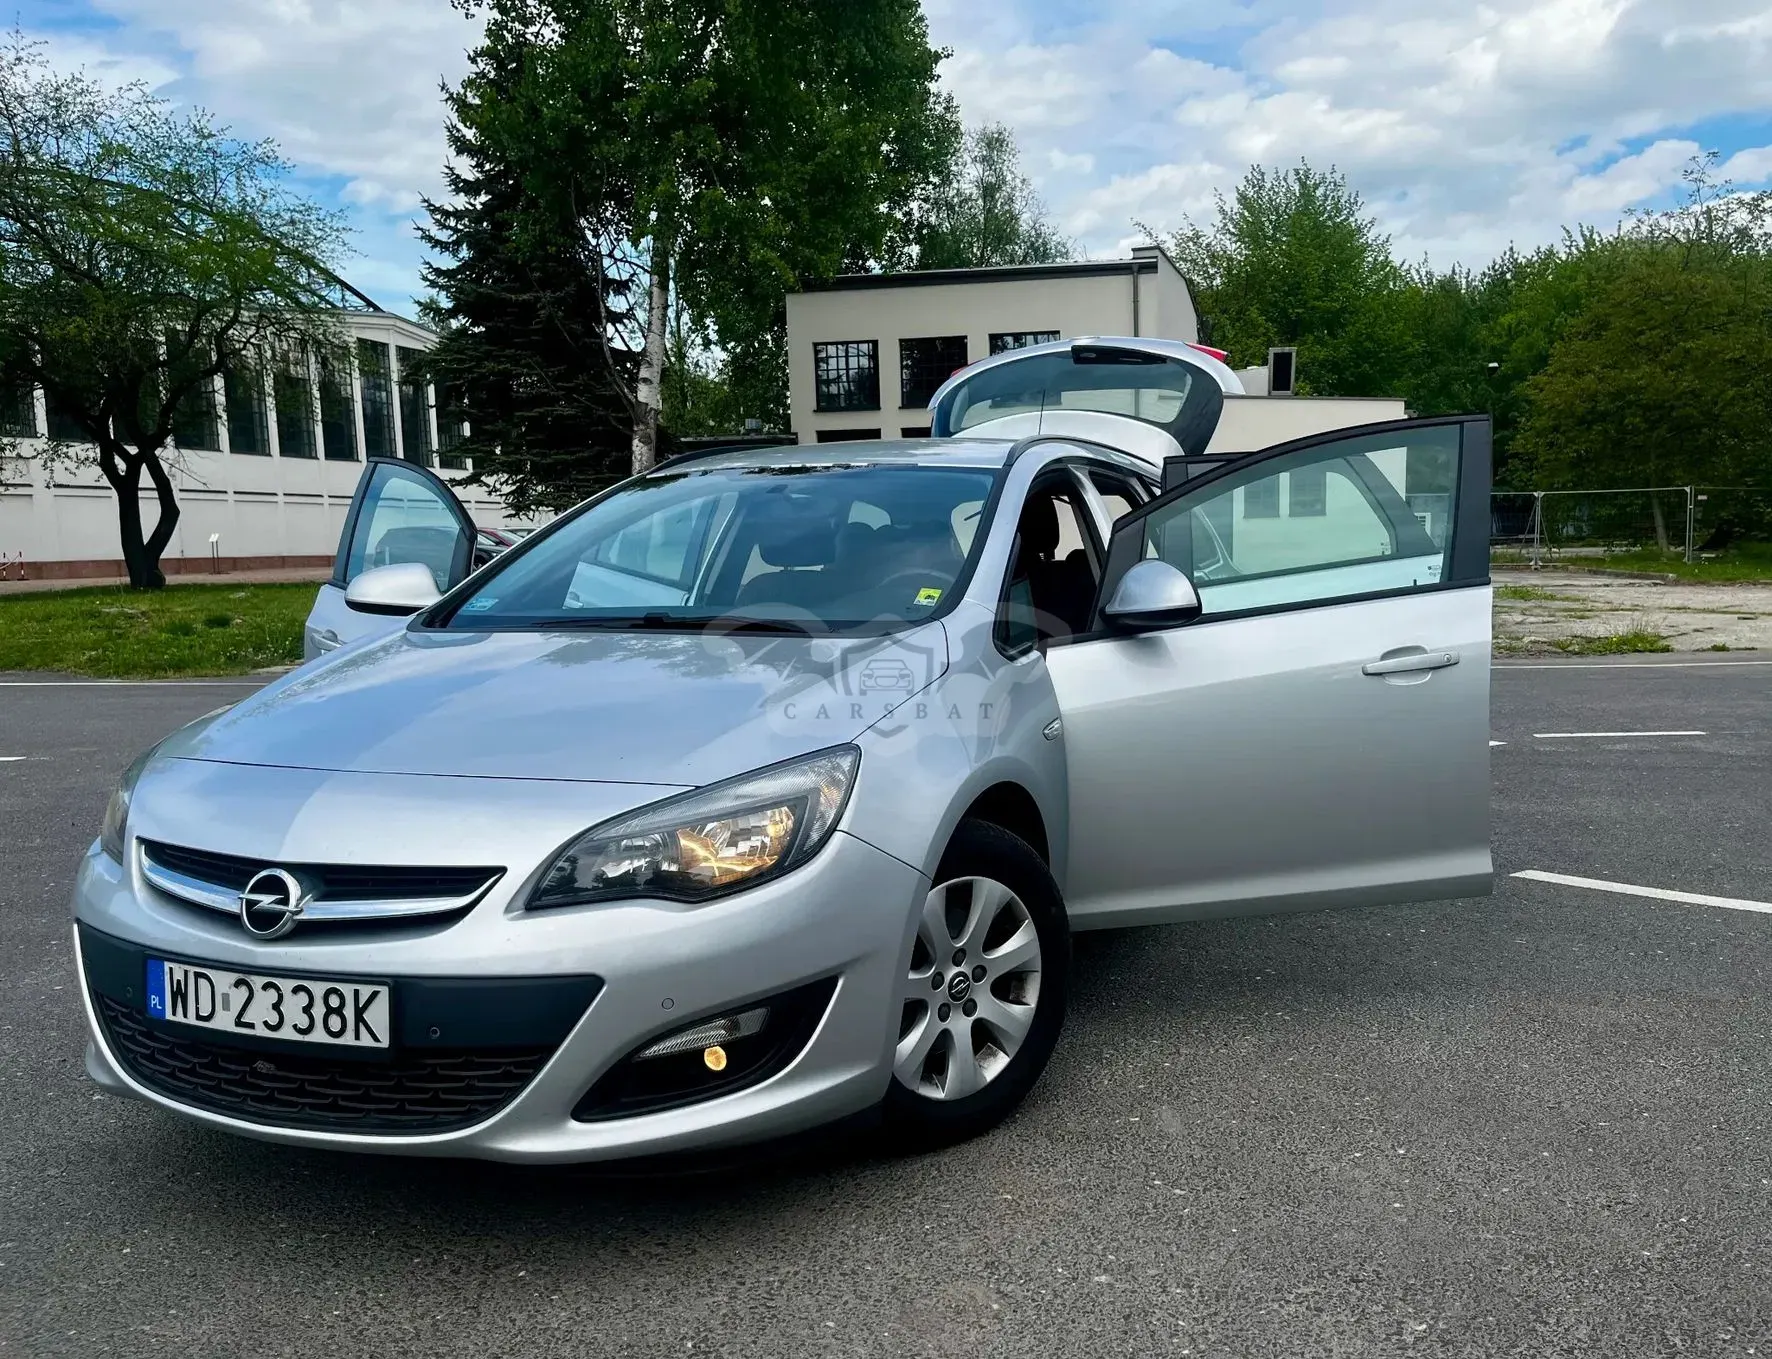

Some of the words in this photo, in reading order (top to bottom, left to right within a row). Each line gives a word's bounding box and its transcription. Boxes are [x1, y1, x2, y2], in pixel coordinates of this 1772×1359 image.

[150, 995, 162, 1010] PL
[168, 966, 216, 1023] WD
[233, 977, 383, 1044] 2338K
